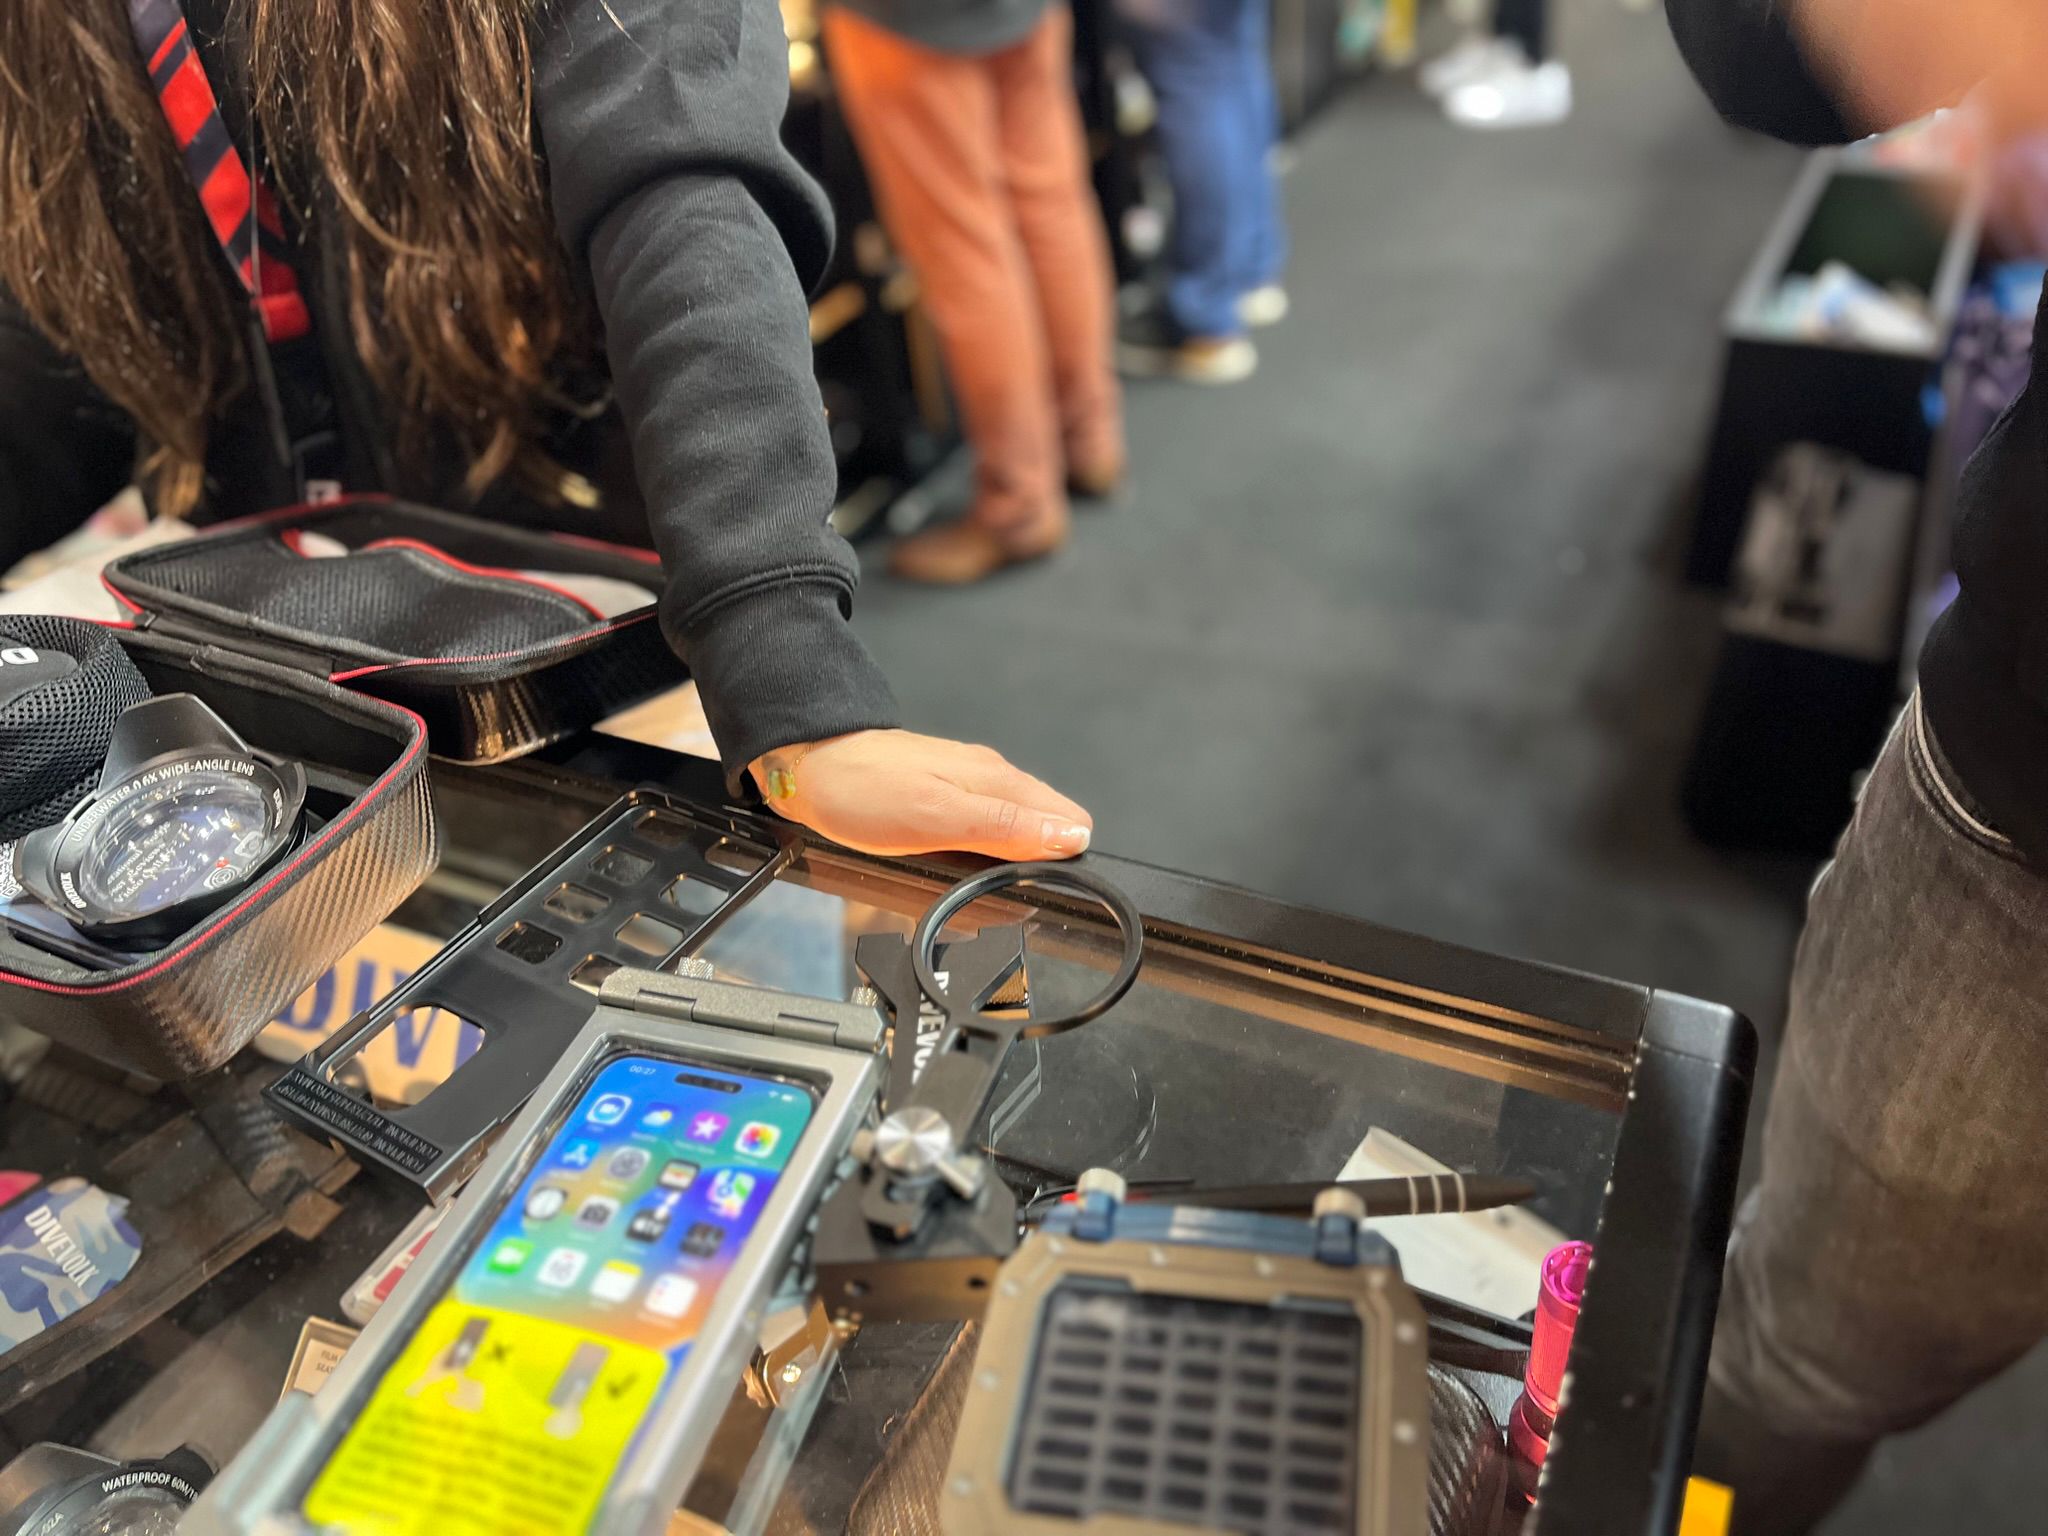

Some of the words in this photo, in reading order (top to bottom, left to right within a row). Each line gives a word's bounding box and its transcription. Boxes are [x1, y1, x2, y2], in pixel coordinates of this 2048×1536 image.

[0, 646, 40, 667] D
[71, 785, 131, 843] UNDERWATER
[159, 759, 230, 780] WIDE-ANGLE
[231, 759, 255, 777] LENS
[276, 957, 485, 1071] DIV
[24, 1204, 100, 1289] DIVEVOLK
[102, 1472, 171, 1493] WATERPROOF
